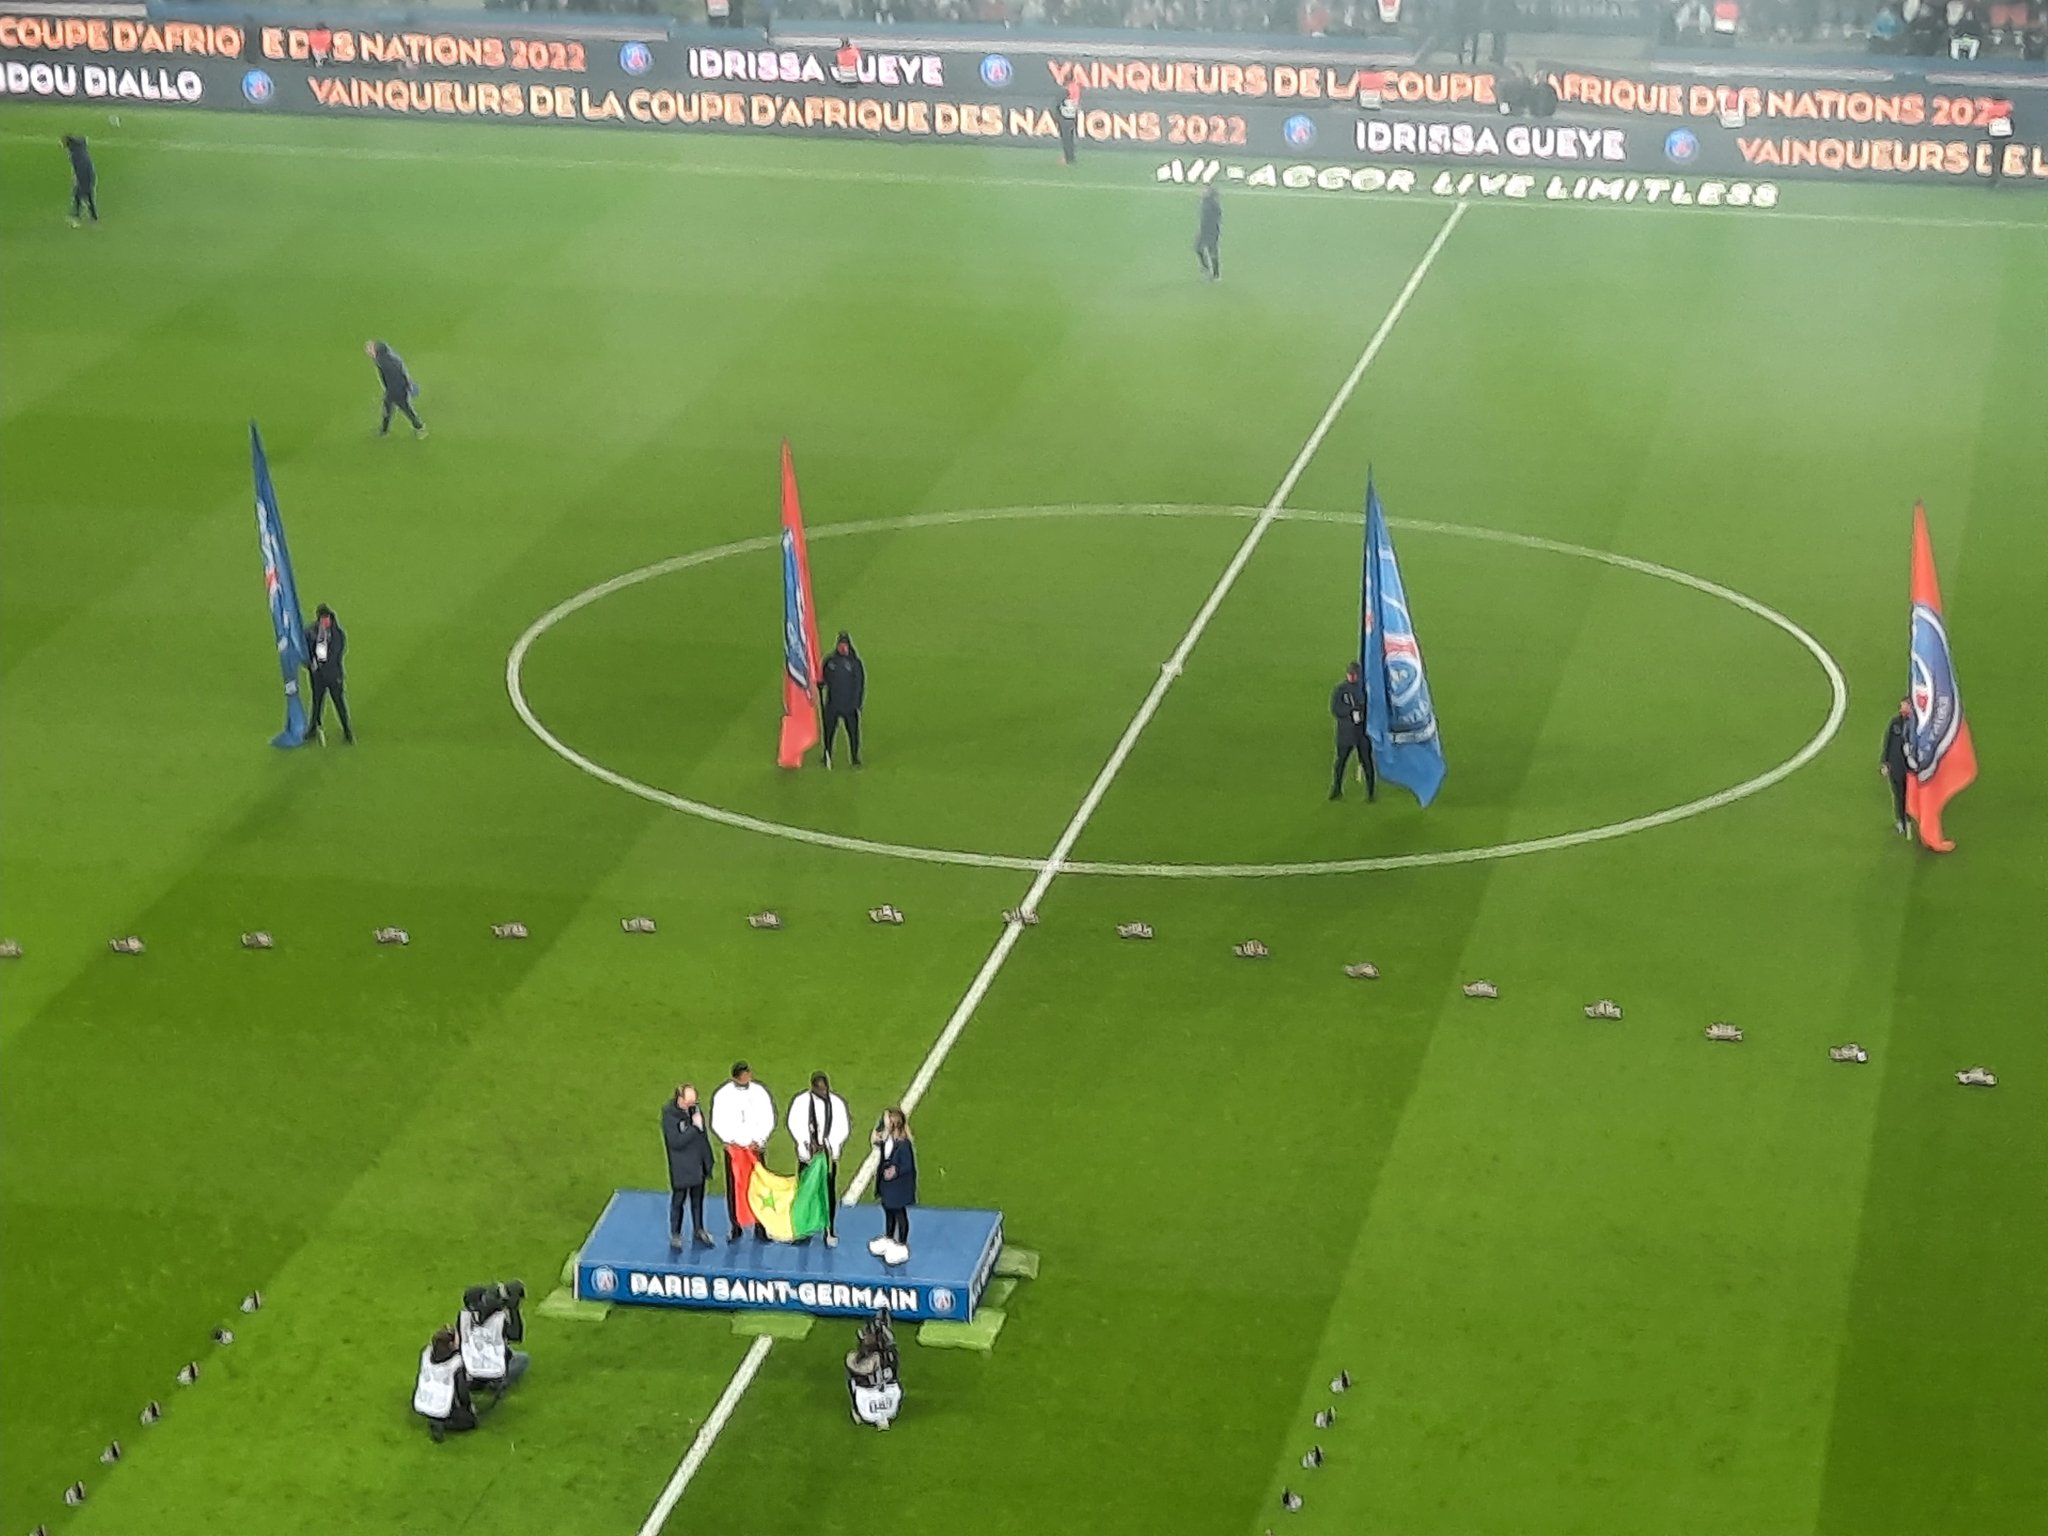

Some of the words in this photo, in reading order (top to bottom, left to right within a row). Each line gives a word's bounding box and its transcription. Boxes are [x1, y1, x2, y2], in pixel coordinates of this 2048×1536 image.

[0, 16, 110, 51] COUPE
[112, 20, 284, 60] D'AFRIQE
[288, 28, 355, 62] DS
[359, 31, 506, 69] NATIONS
[509, 38, 586, 73] 2022
[83, 64, 204, 102] DIALLO
[687, 47, 825, 84] IDRISSA
[308, 75, 525, 115] VAINQUEURS
[529, 84, 577, 118] DE
[580, 87, 626, 122] LA
[628, 87, 746, 126] COUPE
[750, 93, 932, 136] D'AFRIQUE
[935, 102, 1004, 137] DES
[1009, 107, 1162, 141] NAIONS
[1167, 112, 1247, 145] 2022
[1048, 58, 1268, 97] VAINQUEURS
[1273, 65, 1321, 98] DE
[1689, 84, 1762, 118] DS
[1767, 88, 1926, 126] NATIONS
[1932, 95, 2013, 127] 202
[1356, 120, 1499, 155] IDRISSA
[1505, 123, 1627, 160] GUEYE
[1736, 136, 1970, 176] VAINQUEURS
[1431, 170, 1536, 199] LIVE
[1546, 175, 1779, 207] LIMITLESS
[630, 1272, 709, 1300] PARIS
[713, 1277, 918, 1312] SAINT-GERMAIN
